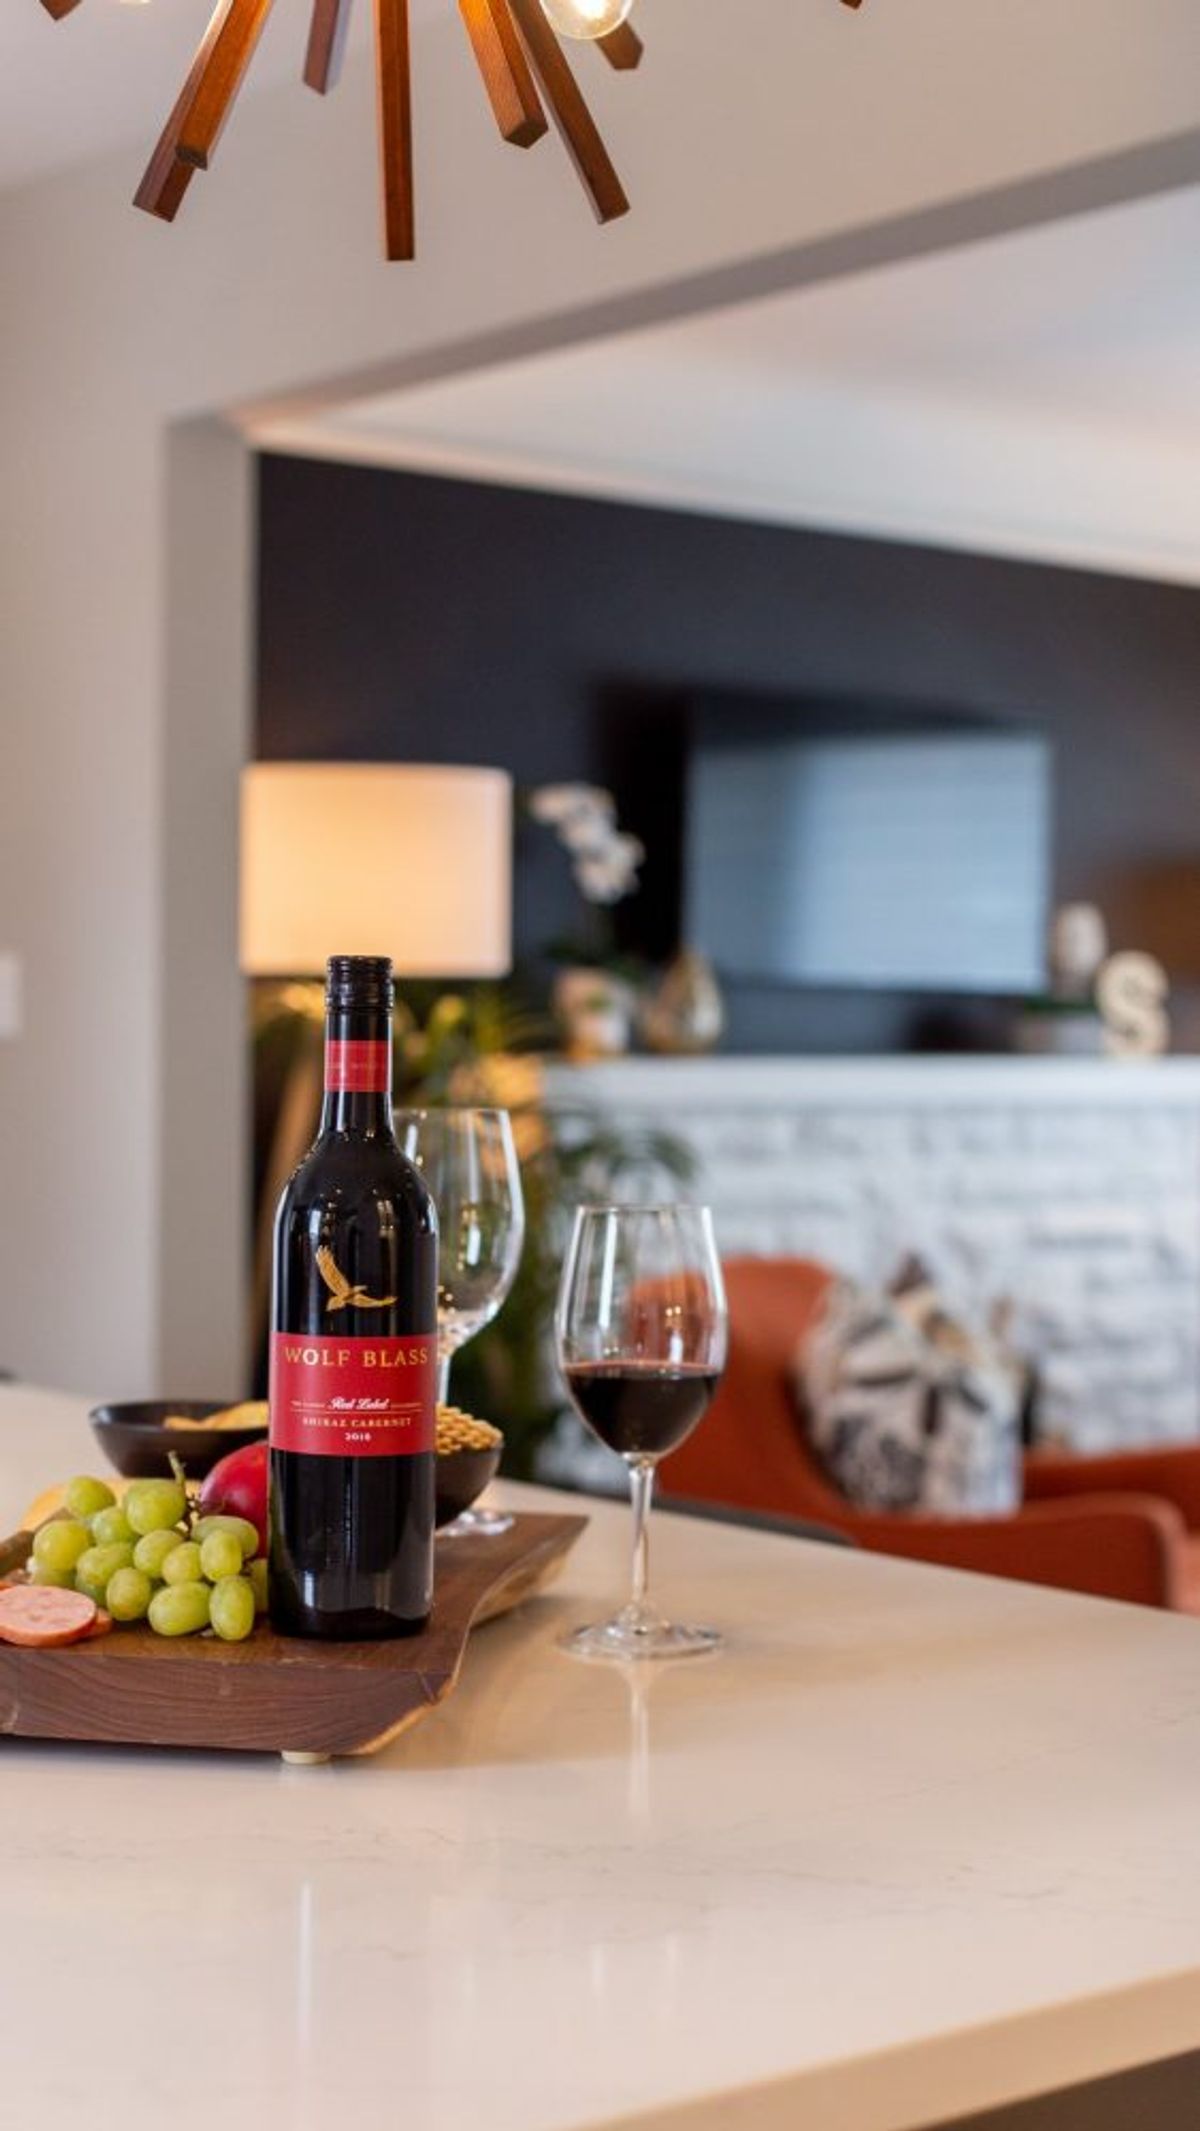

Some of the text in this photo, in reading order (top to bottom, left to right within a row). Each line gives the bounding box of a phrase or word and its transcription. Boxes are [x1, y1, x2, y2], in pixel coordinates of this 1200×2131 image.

[1097, 949, 1168, 1058] S
[285, 1347, 428, 1367] WOLF BLASS
[329, 1397, 355, 1410] Red
[356, 1399, 390, 1411] Label
[303, 1417, 411, 1427] SHIRAZ CABERNET
